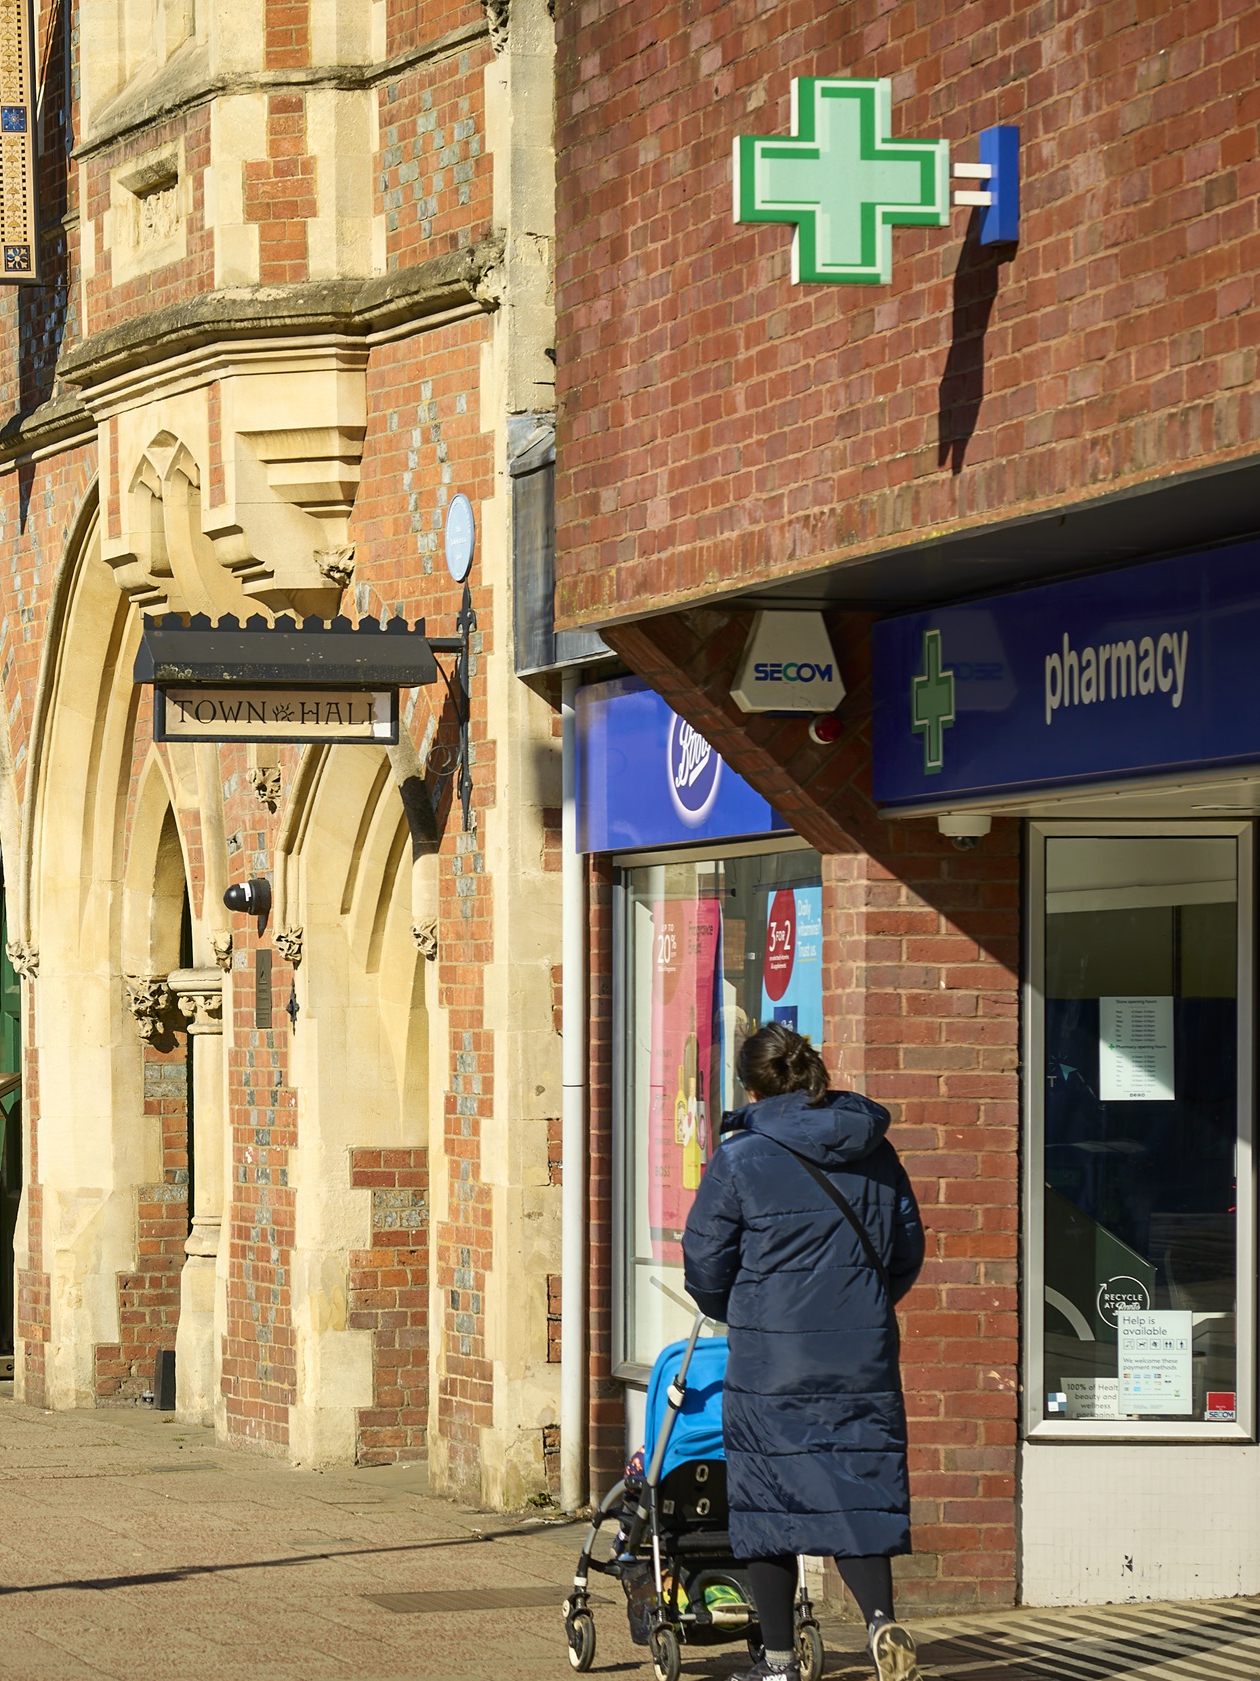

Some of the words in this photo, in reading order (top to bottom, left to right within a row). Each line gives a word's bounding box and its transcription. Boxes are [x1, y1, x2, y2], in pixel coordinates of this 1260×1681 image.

[754, 662, 833, 683] SECOM
[1045, 630, 1189, 725] pharmacy
[173, 700, 268, 725] TOWN
[768, 922, 777, 952] 3
[776, 930, 786, 942] FOR
[783, 920, 791, 951] 2
[1104, 1293, 1143, 1301] RECYCLE
[1123, 1316, 1146, 1327] Help
[1148, 1316, 1156, 1325] is
[1123, 1327, 1168, 1336] available
[1123, 1364, 1150, 1372] payment
[1151, 1363, 1177, 1371] methods
[1067, 1383, 1087, 1391] 100%
[1088, 1383, 1096, 1391] of
[1098, 1383, 1119, 1391] Healt
[1075, 1393, 1100, 1401] beauty
